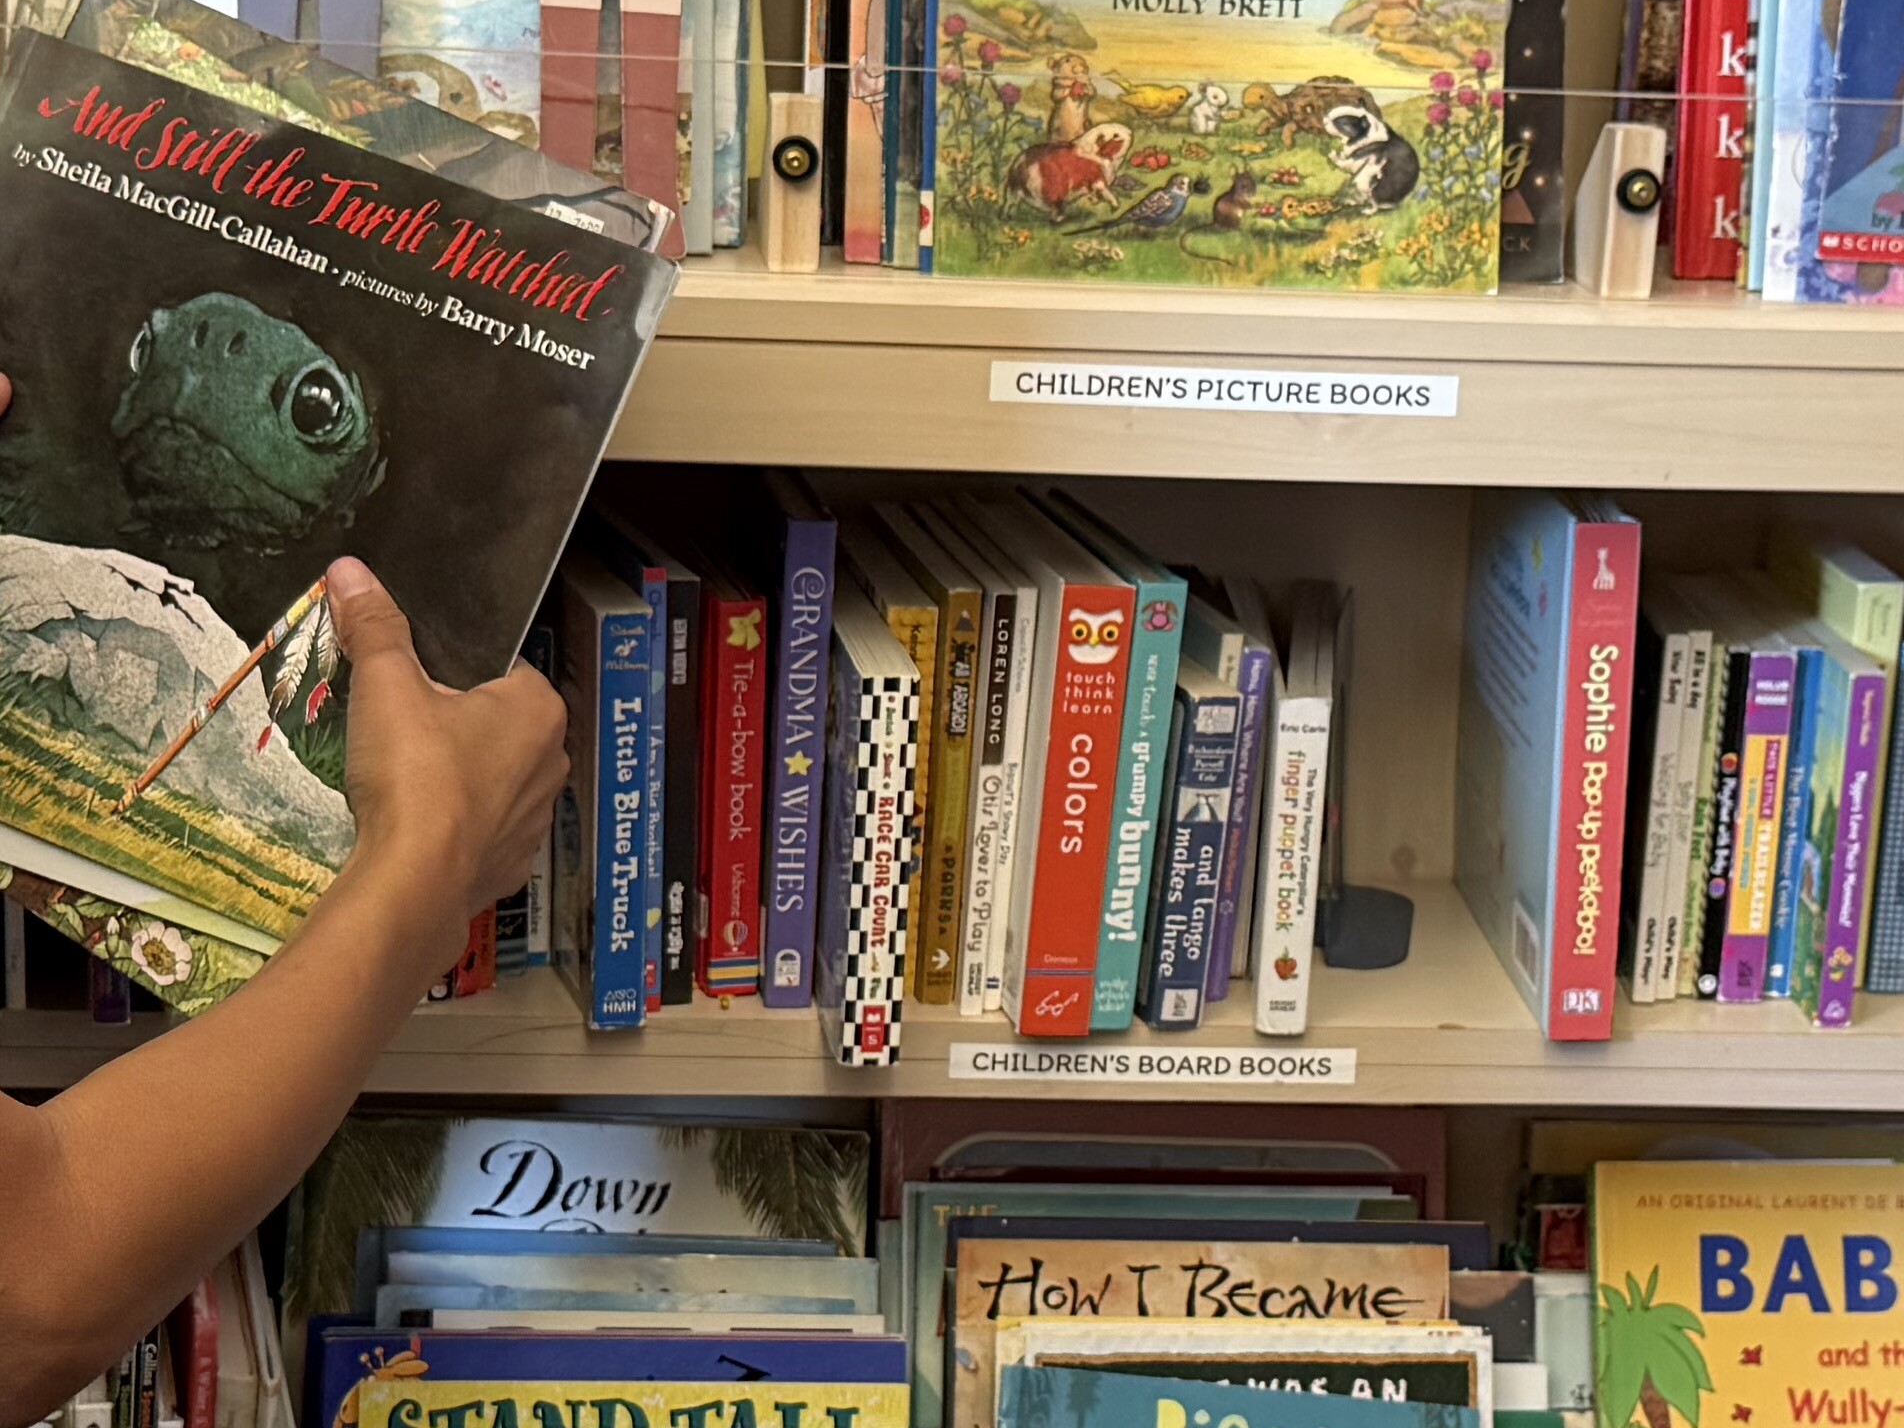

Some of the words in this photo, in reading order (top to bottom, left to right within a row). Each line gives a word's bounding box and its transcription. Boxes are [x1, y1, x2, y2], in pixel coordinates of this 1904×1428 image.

[37, 85, 167, 152] And
[136, 116, 250, 194] Still
[244, 148, 312, 211] the
[307, 173, 439, 257] Turtle
[437, 218, 625, 323] Watched
[1871, 212, 1893, 231] by
[12, 143, 36, 167] by
[36, 147, 113, 194] Sheila
[114, 172, 329, 275] MacGill-Callahan
[340, 267, 429, 308] pictures
[416, 290, 440, 317] by
[440, 297, 517, 347] Barry
[514, 323, 595, 371] Moser
[1015, 372, 1188, 400] CHILDREN'S
[1195, 377, 1321, 405] PICTURE
[1329, 381, 1431, 408] BOOKS
[785, 567, 826, 746] GRANDMA
[1583, 644, 1620, 754] Sophie
[612, 697, 643, 784] Little
[612, 790, 642, 855] Blue
[1059, 732, 1099, 855] colors
[1576, 760, 1608, 841] pop-up
[775, 784, 811, 915] WISHES
[610, 859, 642, 954] Truck
[1573, 842, 1601, 956] peekaboo!
[972, 1051, 1130, 1075] CHILDREN'S
[1138, 1055, 1231, 1076] BOARD
[1239, 1057, 1332, 1076] BOOKS
[470, 1139, 673, 1219] Down
[1635, 1194, 1663, 1209] AN
[1669, 1194, 1764, 1210] ORIGINAL
[1771, 1194, 1858, 1210] LAURENT
[1864, 1195, 1888, 1210] DE
[1817, 1340, 1870, 1368] and
